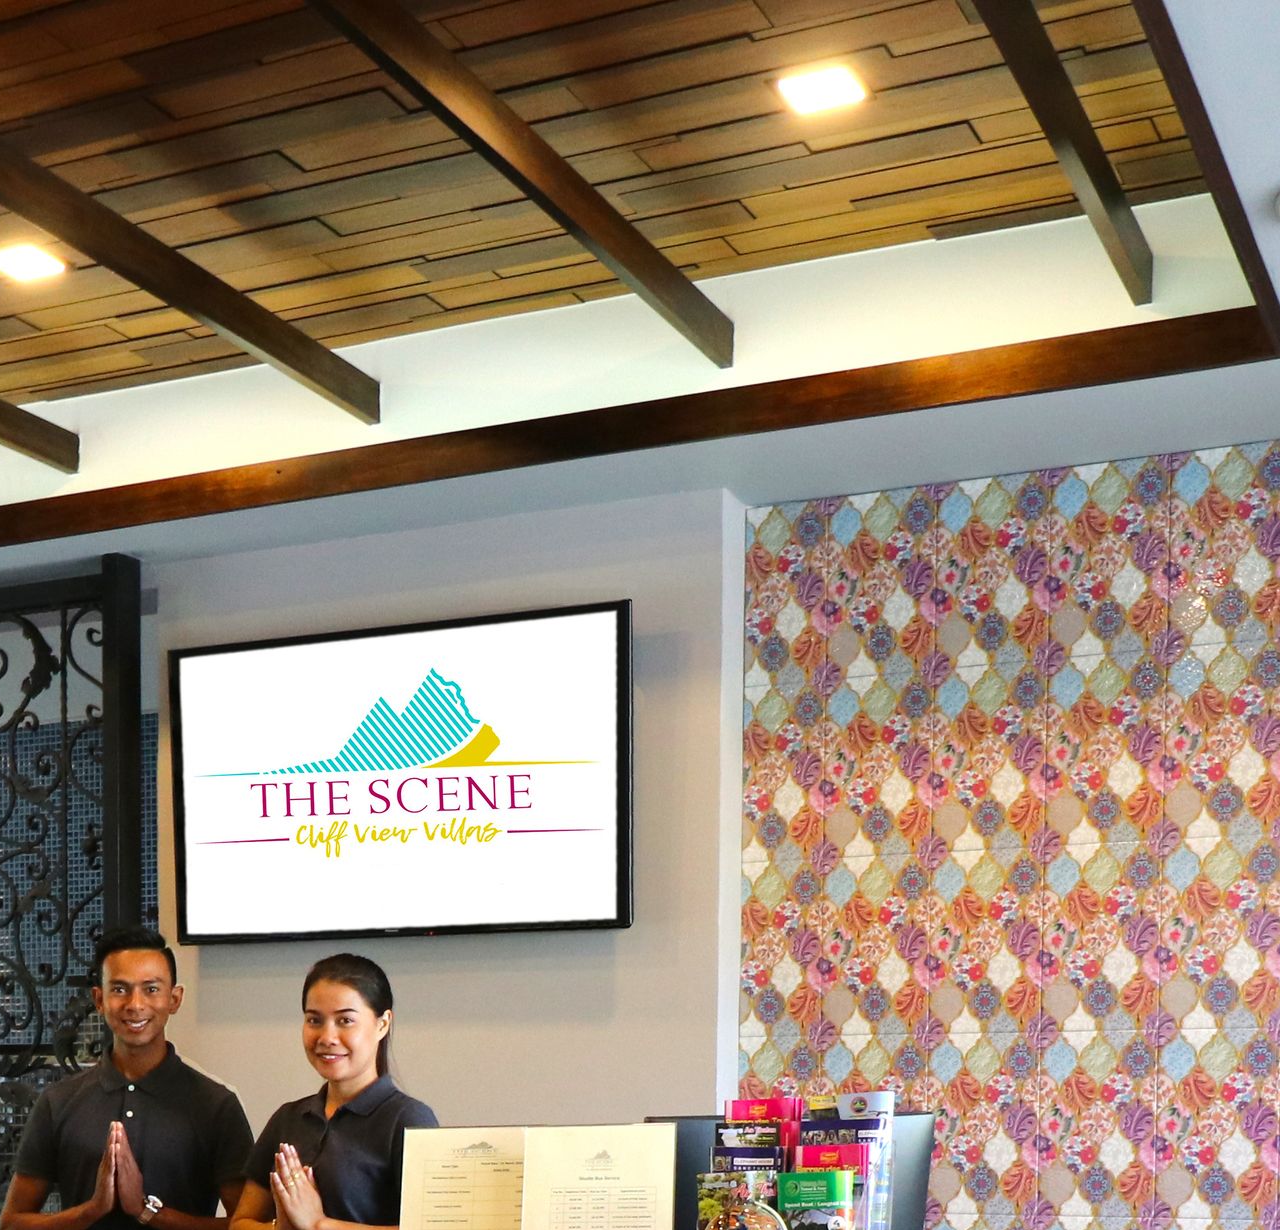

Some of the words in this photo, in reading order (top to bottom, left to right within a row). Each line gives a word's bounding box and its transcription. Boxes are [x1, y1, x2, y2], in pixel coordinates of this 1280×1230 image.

[250, 781, 351, 818] THE
[367, 774, 532, 815] SCENE
[295, 820, 349, 859] Cliff
[353, 823, 419, 846] View
[423, 816, 504, 846] Villas
